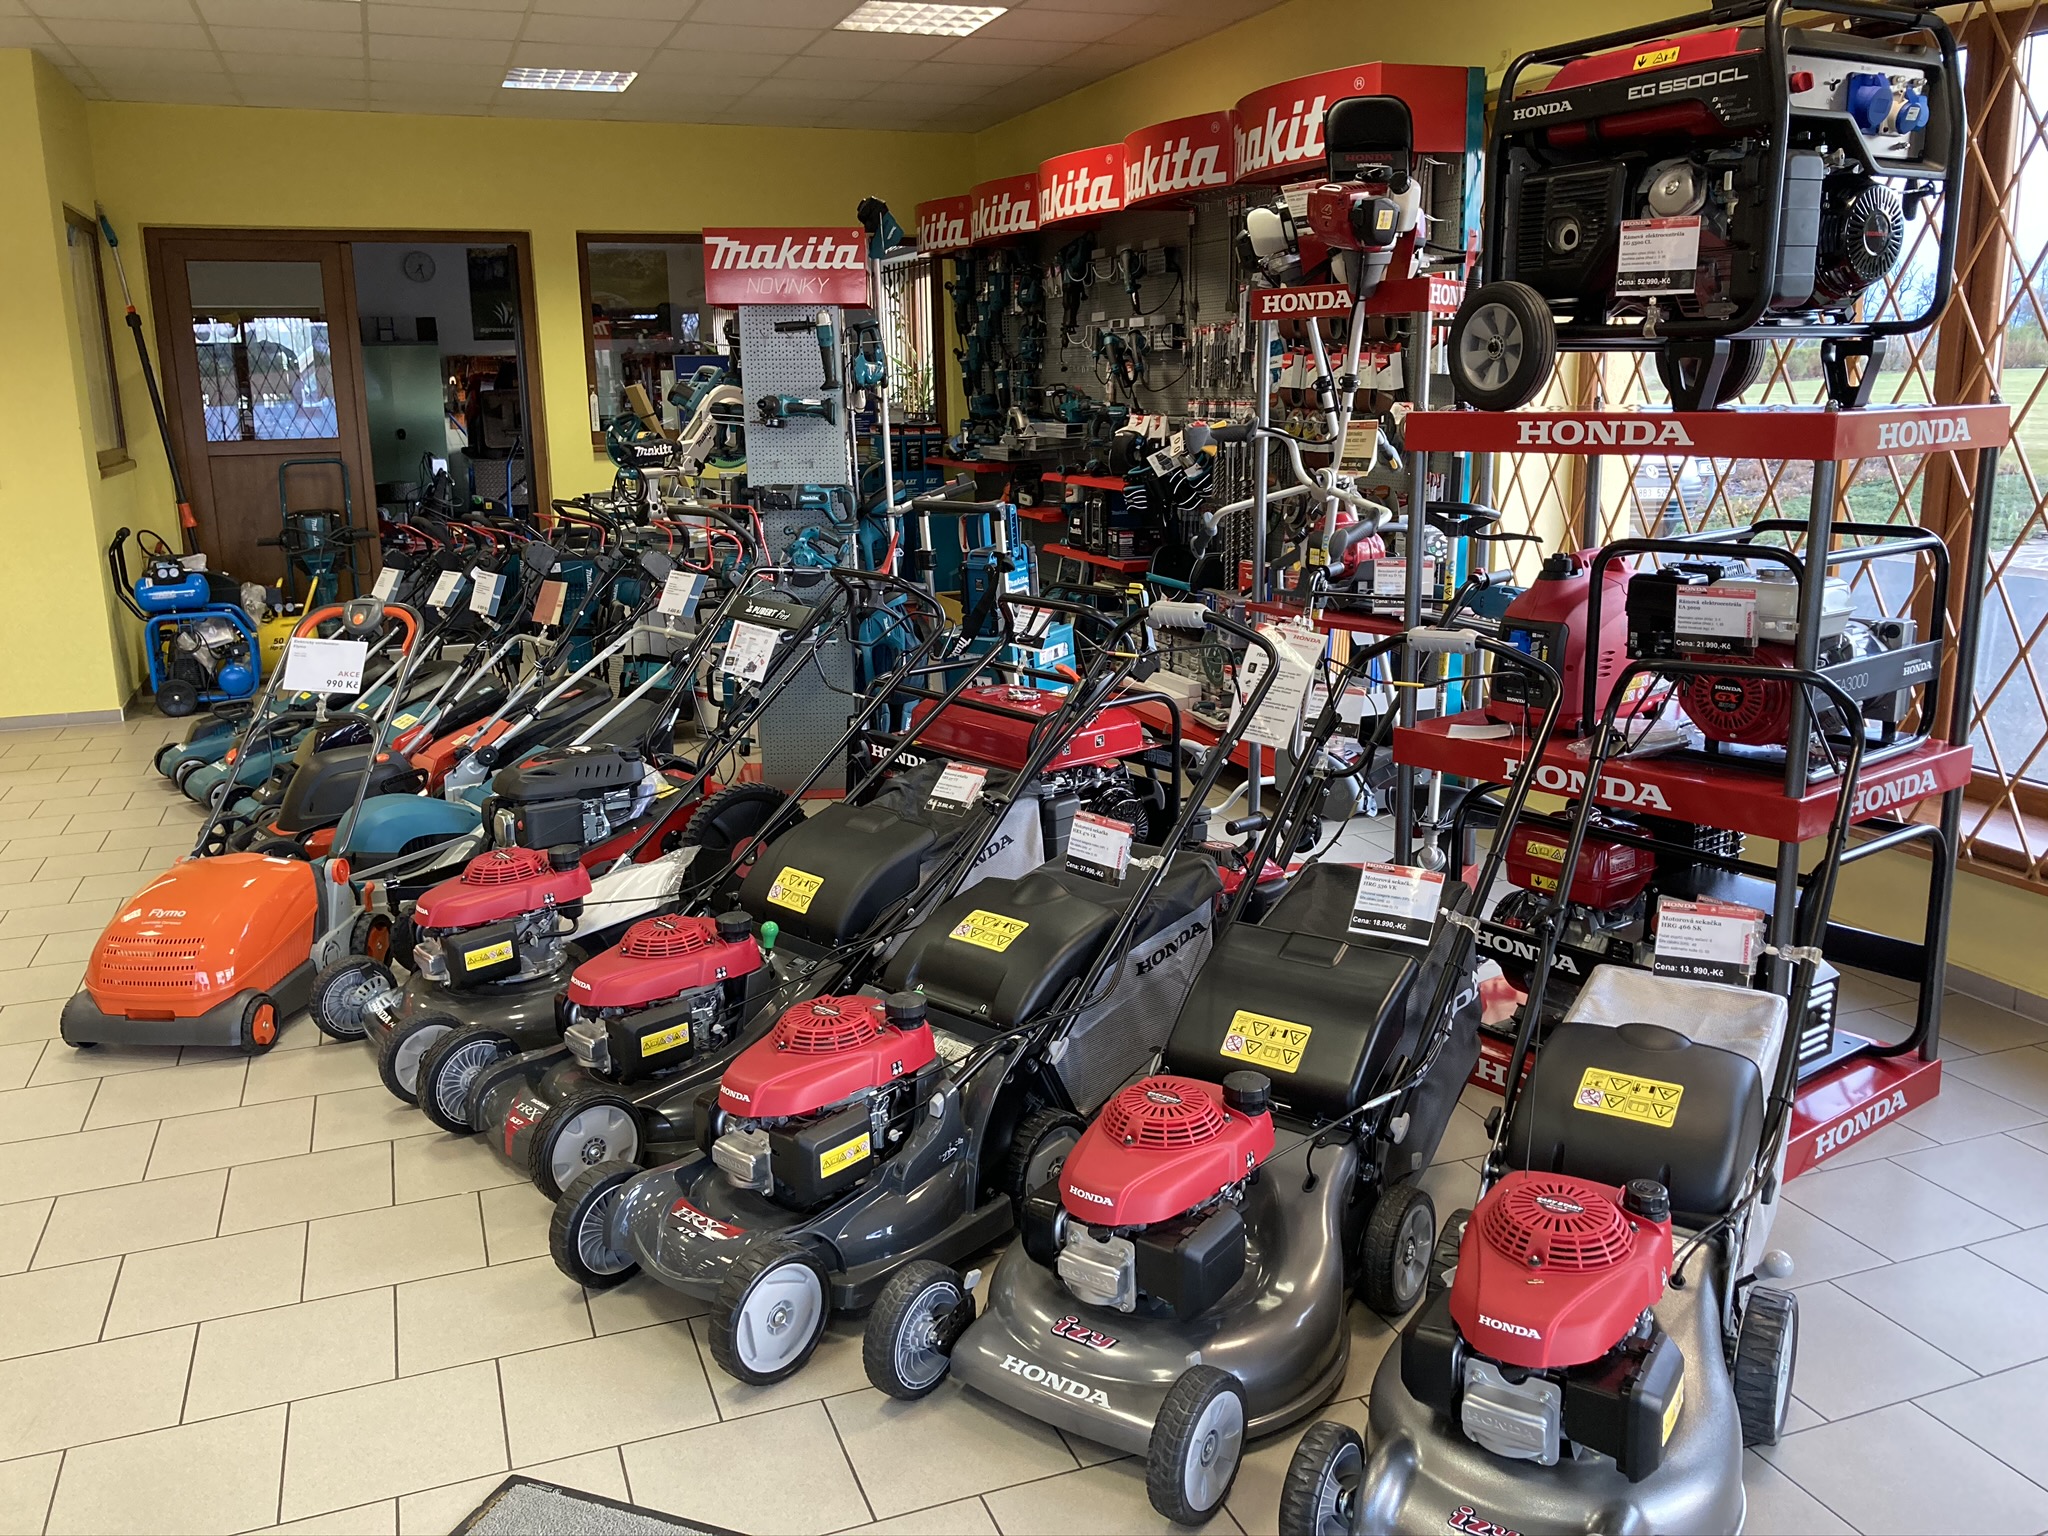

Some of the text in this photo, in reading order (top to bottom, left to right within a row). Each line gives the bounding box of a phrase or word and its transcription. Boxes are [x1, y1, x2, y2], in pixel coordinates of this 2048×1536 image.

[1628, 82, 1656, 101] EG
[1513, 100, 1573, 121] HONDA
[1344, 153, 1393, 162] HONDA
[1039, 166, 1120, 224] akita
[1623, 219, 1652, 227] HONDA
[704, 236, 865, 270] Makita
[746, 277, 830, 295] NOVINKY
[1430, 282, 1465, 307] HON
[1262, 289, 1352, 314] HONDA
[1516, 419, 1695, 447] HONDA
[1877, 416, 1972, 451] HONDA
[751, 605, 778, 617] PUBERT
[1293, 634, 1322, 644] HONDA
[1675, 639, 1696, 647] Cena:
[1903, 660, 1933, 676] HONDA
[326, 679, 359, 689] 990 Kč
[1714, 684, 1743, 693] HONDA
[1065, 860, 1080, 871] Cena:
[1366, 862, 1396, 871] HONDA
[1364, 874, 1391, 884] Motorová
[148, 908, 187, 918] Flymo
[1663, 901, 1698, 910] HONDA
[1352, 915, 1372, 925] Cena:
[1661, 914, 1722, 927] Motorová sekačka
[1661, 921, 1703, 932] HRG 466 SK
[1136, 921, 1208, 977] HONDA
[1475, 930, 1581, 976] HONA
[1654, 962, 1678, 972] Cena:
[720, 1084, 751, 1103] HONDA
[515, 1101, 544, 1122] HRX
[530, 1098, 550, 1111] HONDA
[1813, 1089, 1908, 1160] HONDA
[1069, 1184, 1114, 1207] HONDA
[671, 1206, 728, 1242] HRX
[676, 1225, 698, 1239] 476
[1061, 1263, 1113, 1290] HONDA
[1052, 1315, 1118, 1350] izy
[1478, 1314, 1542, 1340] HONDA
[999, 1353, 1112, 1410] HONDA
[1465, 1409, 1537, 1442] HONDA
